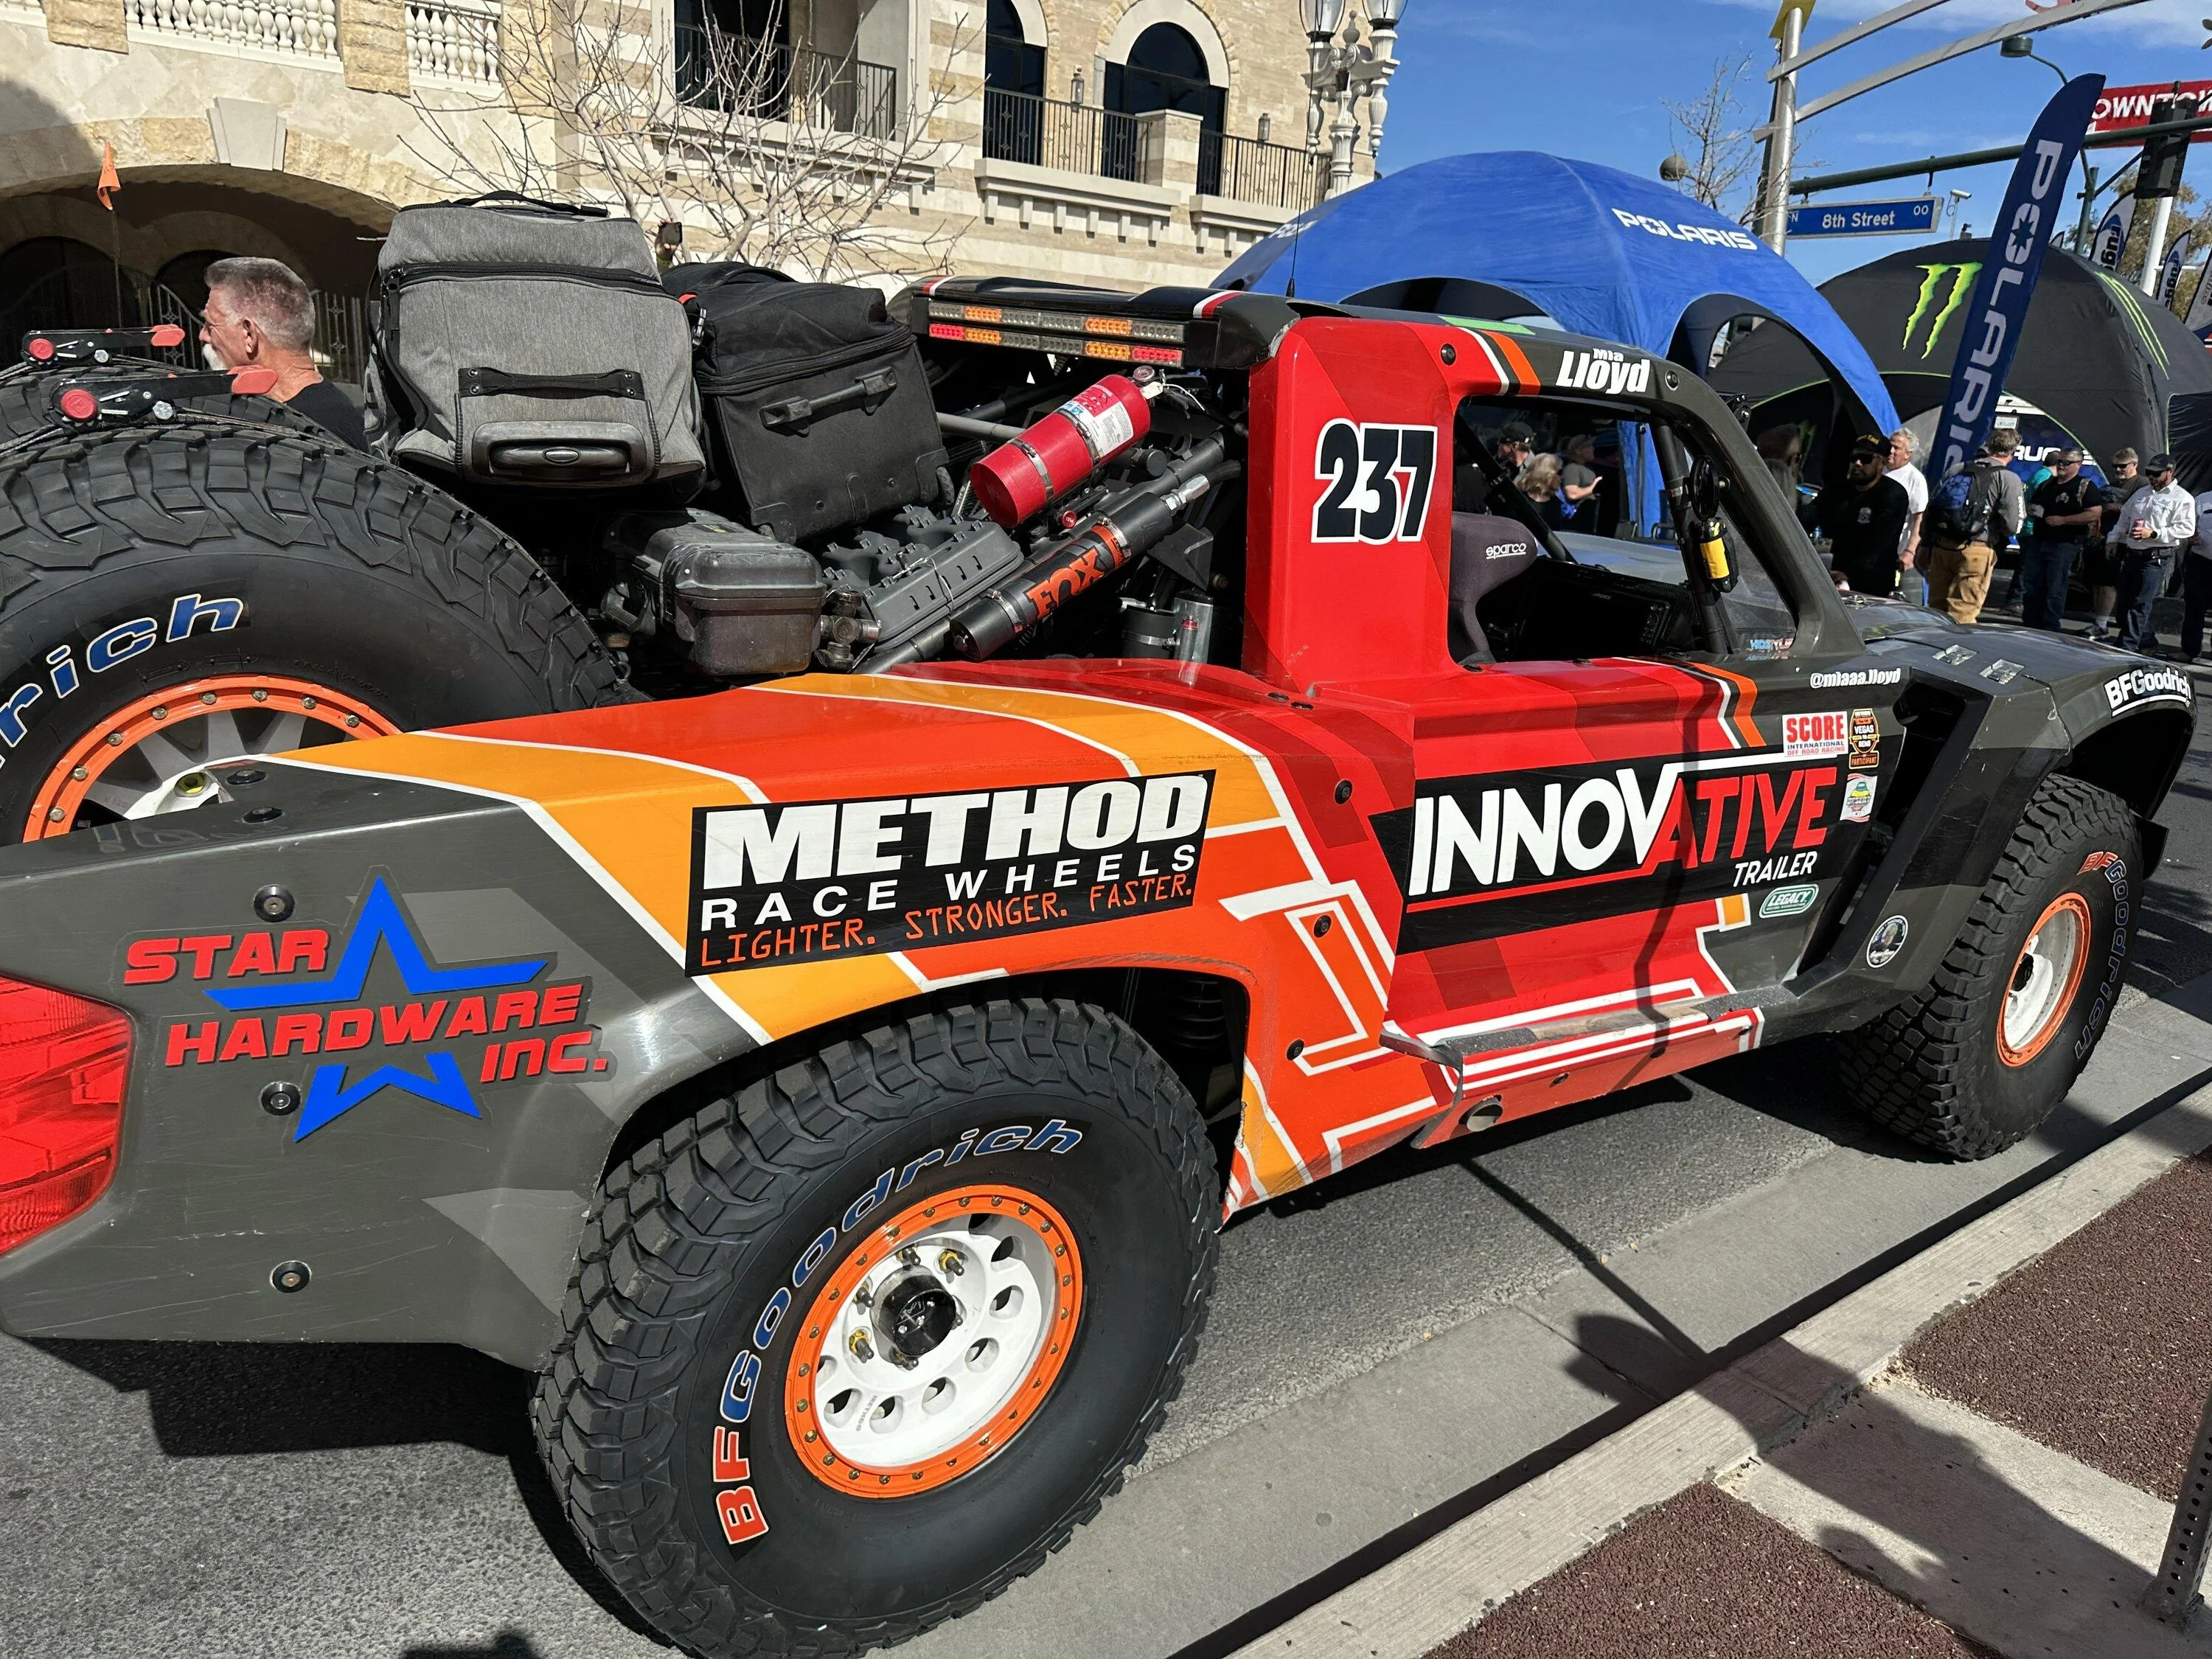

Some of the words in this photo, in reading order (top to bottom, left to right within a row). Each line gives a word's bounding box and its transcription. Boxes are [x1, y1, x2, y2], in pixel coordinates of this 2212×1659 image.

[1612, 208, 1758, 251] POLARIS
[1822, 213, 1845, 229] 8th
[1851, 211, 1896, 227] Street
[1556, 350, 1651, 394] Lloyd
[1312, 418, 1438, 546] 237
[1486, 543, 1527, 560] sparco
[1023, 546, 1105, 619] FOX
[0, 594, 244, 748] rich
[2104, 667, 2191, 709] BFGoodrich
[1787, 714, 1845, 743] SCORE
[1787, 740, 1845, 750] INTERNATIONAL
[1854, 725, 1874, 735] VEGAS
[703, 774, 1208, 890] METHOD
[1408, 765, 1838, 896] INNOVATIVE
[700, 879, 899, 932] RACE
[945, 844, 1197, 901] WHEELS
[1733, 851, 1818, 887] TRAILER
[701, 918, 877, 967] LIGHTER.
[905, 891, 1068, 941] STRONGER.
[1088, 872, 1193, 915] FASTER.
[1767, 890, 1812, 907] LEGACY
[123, 928, 331, 985] STAR
[2076, 851, 2129, 1060] BFGoodrich
[165, 984, 583, 1068] HARDWARE
[480, 1030, 608, 1084] INC.
[713, 1118, 1088, 1545] BFGoodrich
